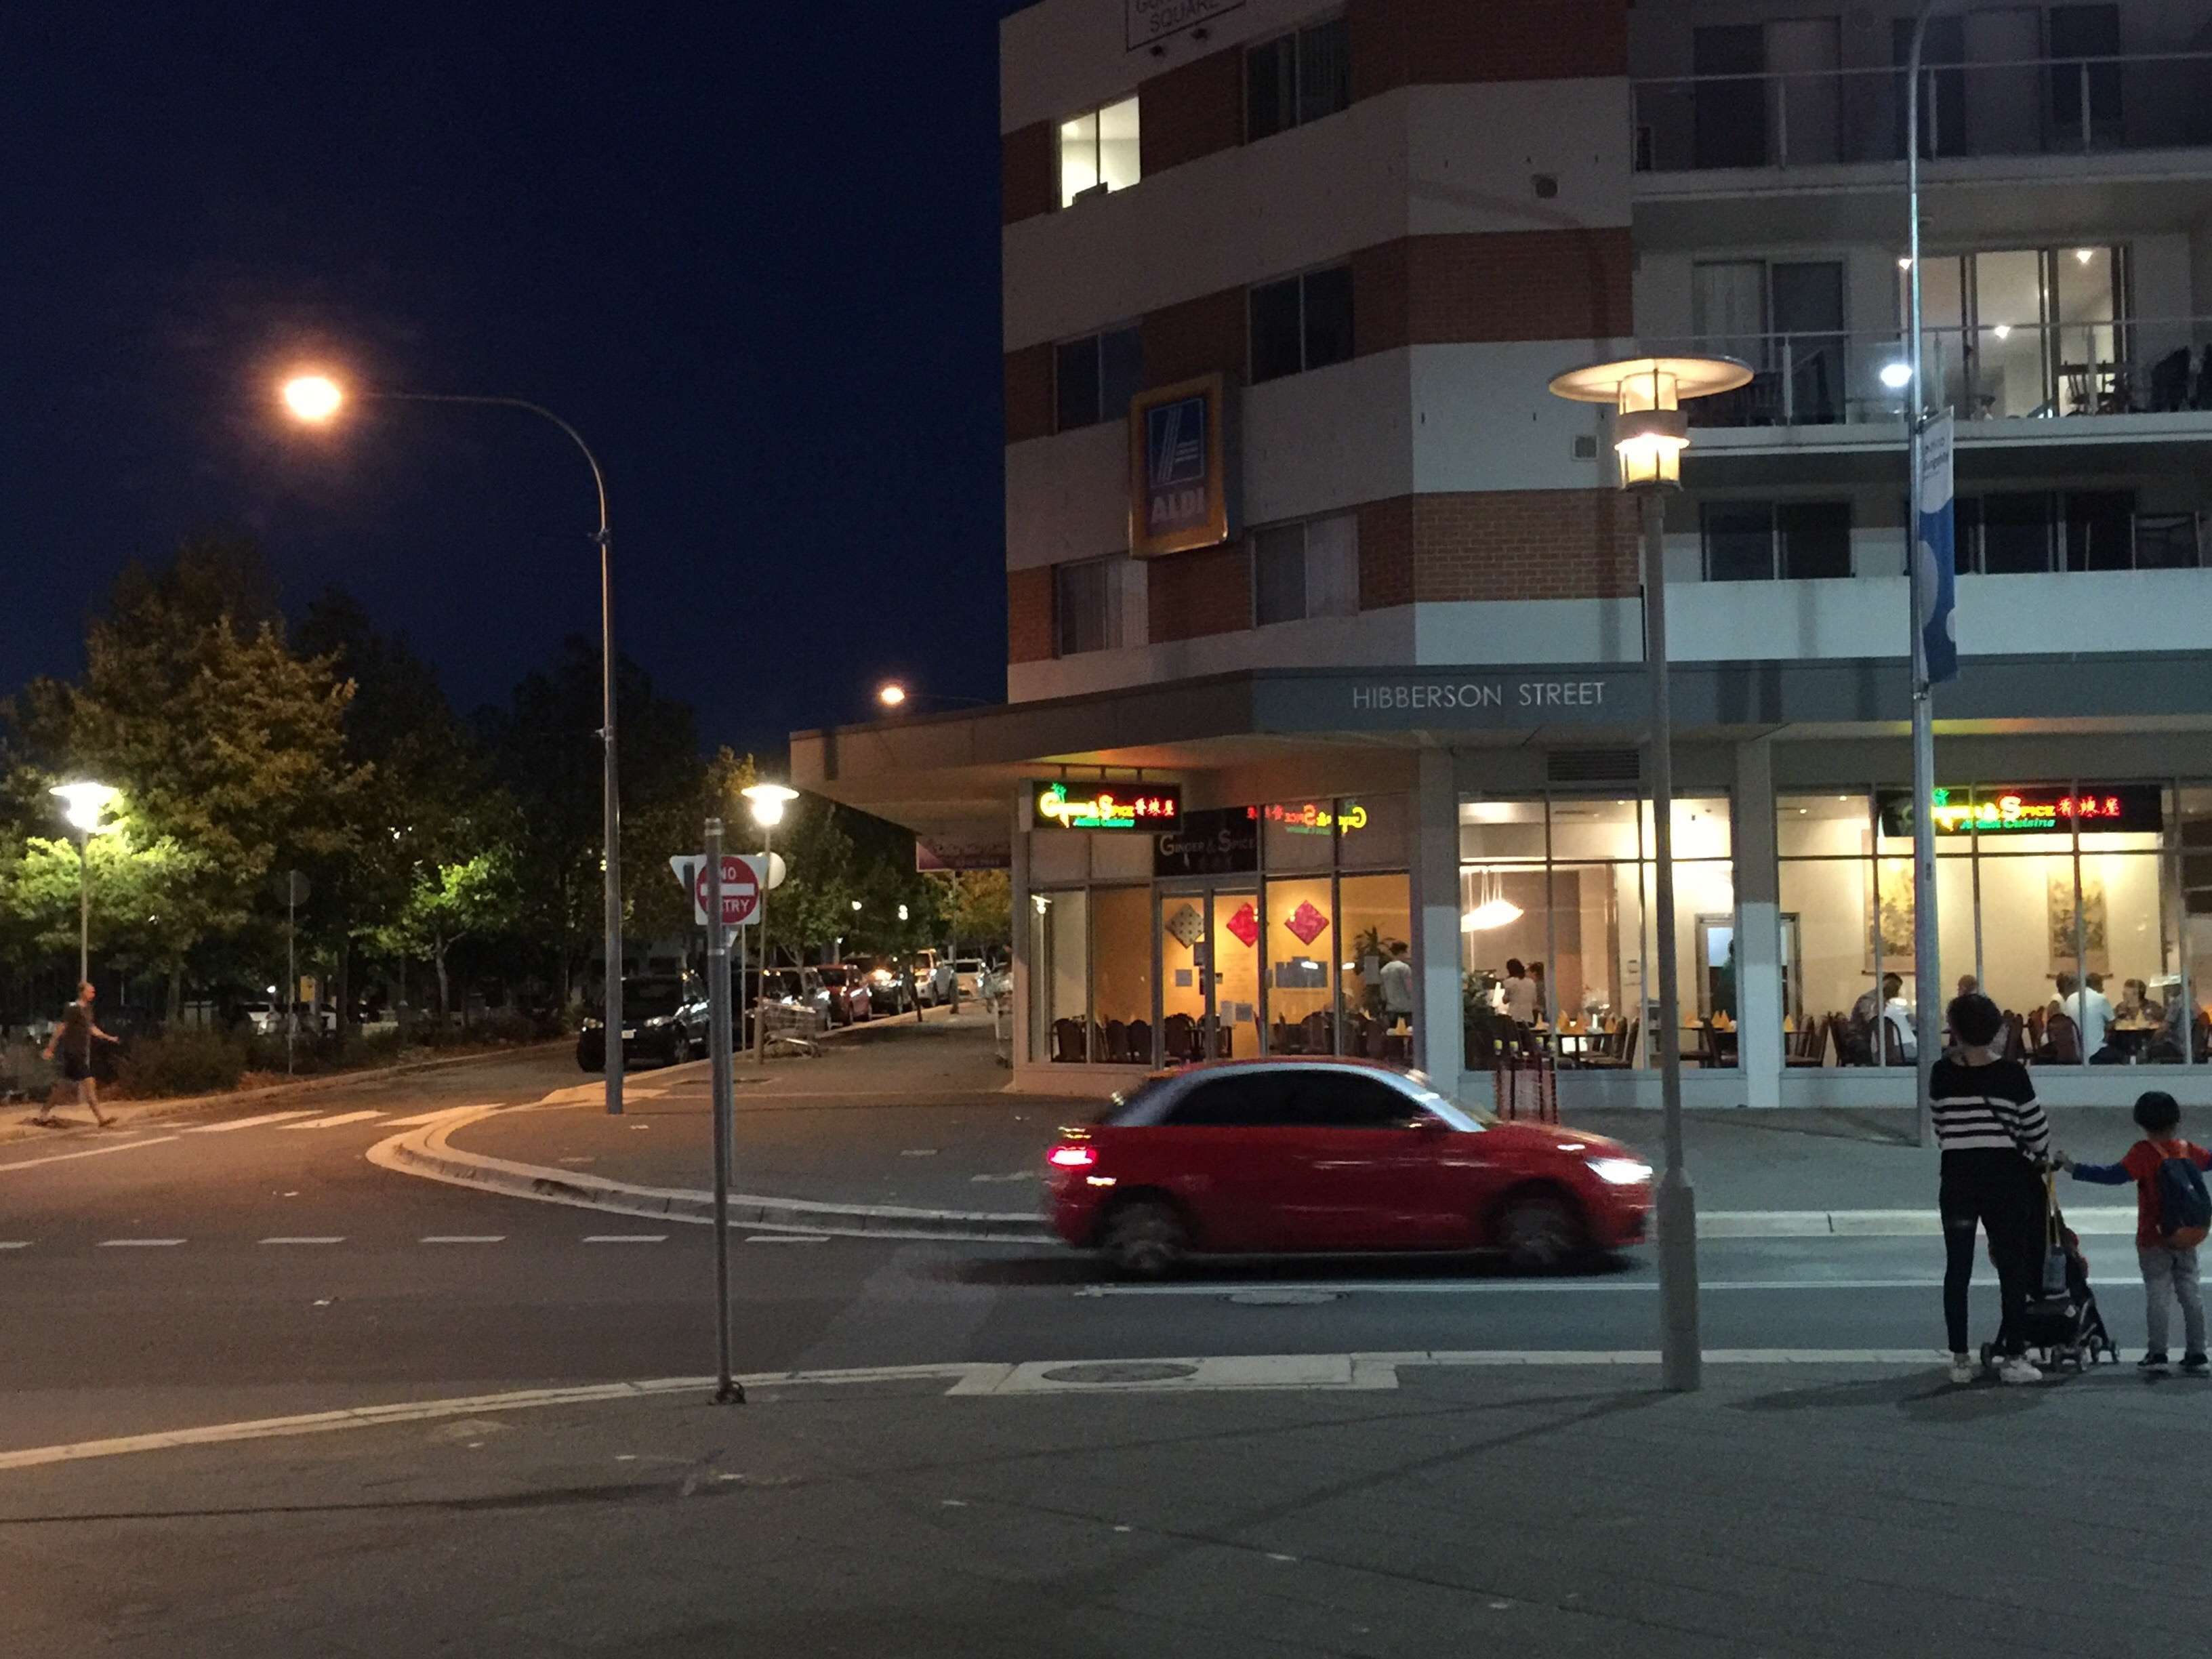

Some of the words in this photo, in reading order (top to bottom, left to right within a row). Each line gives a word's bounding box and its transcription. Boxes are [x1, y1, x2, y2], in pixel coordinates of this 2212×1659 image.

[1151, 487, 1205, 523] ALDI
[1353, 684, 1502, 709] HIBBERSON
[1519, 682, 1605, 706] STREET
[718, 867, 737, 880] NO
[705, 899, 750, 913] TRY
